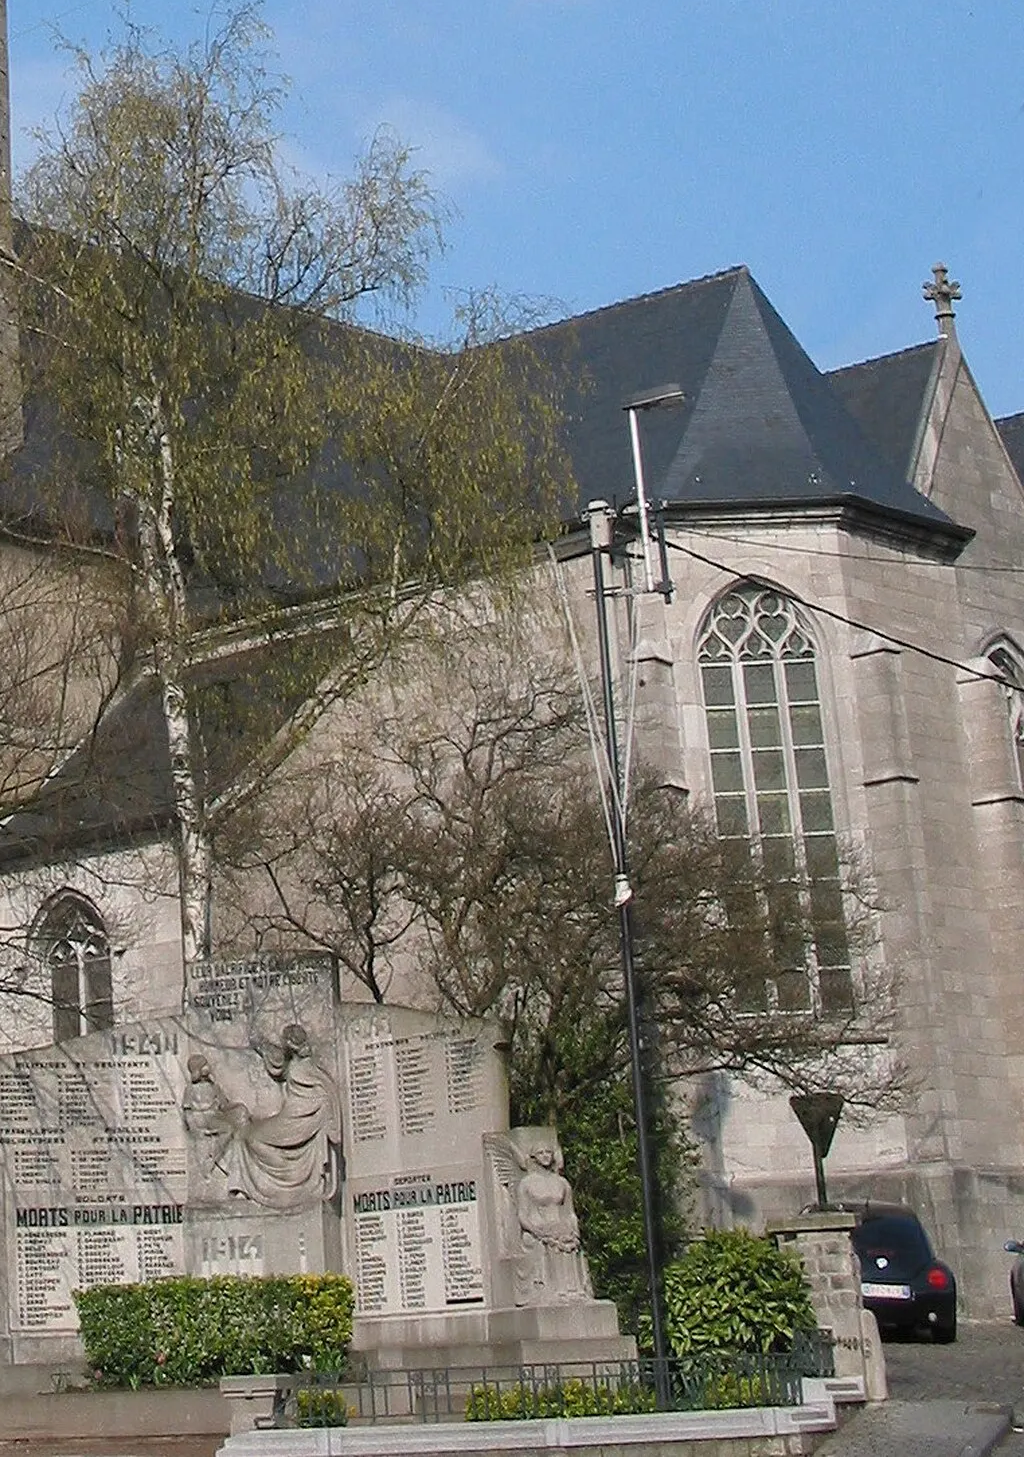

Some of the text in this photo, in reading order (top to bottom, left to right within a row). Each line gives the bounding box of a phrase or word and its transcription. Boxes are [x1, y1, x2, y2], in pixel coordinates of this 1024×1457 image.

[353, 1190, 391, 1213] MORTS
[420, 1188, 434, 1203] LA
[436, 1181, 477, 1204] PATRIE
[16, 1204, 184, 1227] MORTS POUR LA PATRIE
